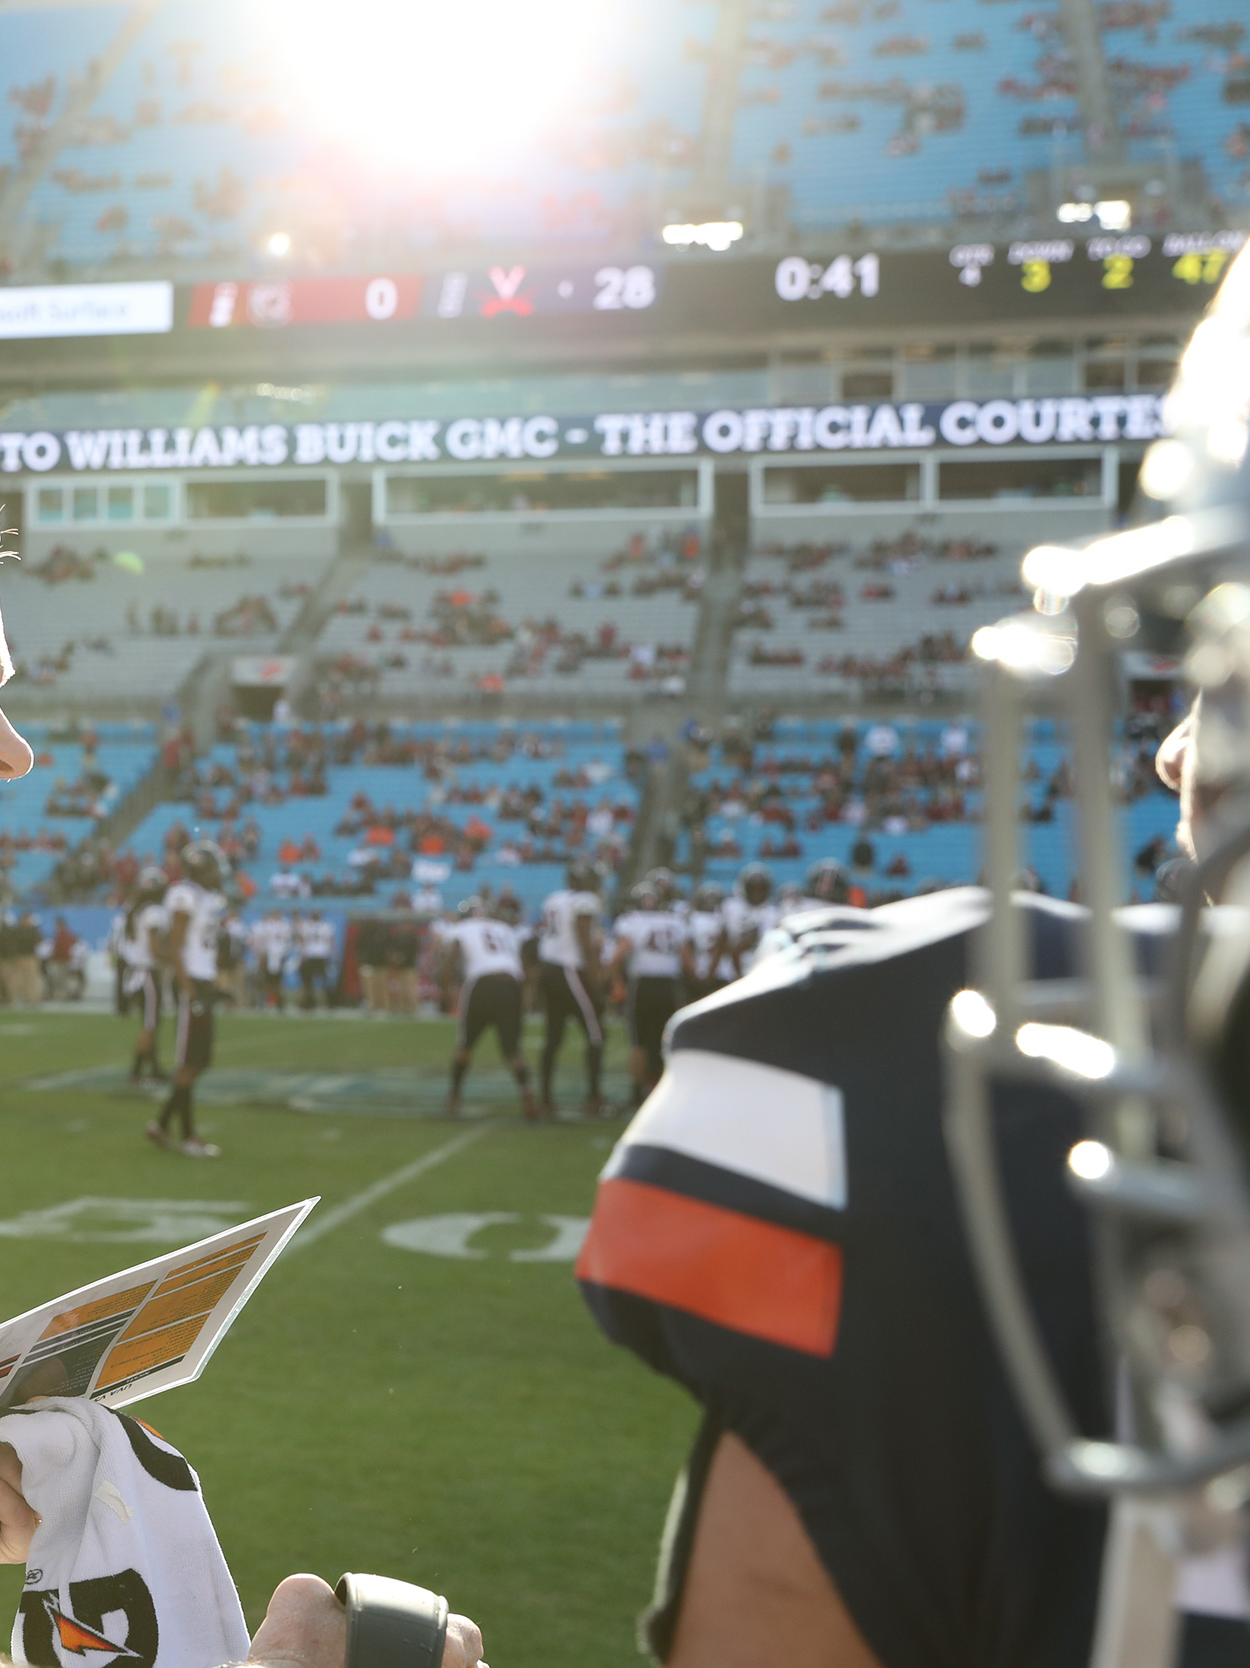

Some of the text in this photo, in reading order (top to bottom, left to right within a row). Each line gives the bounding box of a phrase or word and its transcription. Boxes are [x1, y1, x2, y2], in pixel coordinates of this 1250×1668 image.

[593, 264, 657, 311] 28
[774, 252, 880, 301] 0:41
[1020, 257, 1052, 293] 3
[1101, 253, 1135, 289] 2
[364, 277, 399, 320] 0
[64, 423, 289, 470] WILLIAMS
[291, 419, 442, 465] BUICK
[444, 416, 560, 461] GMC
[593, 411, 699, 456] THE
[701, 402, 936, 453] OFFICIAL
